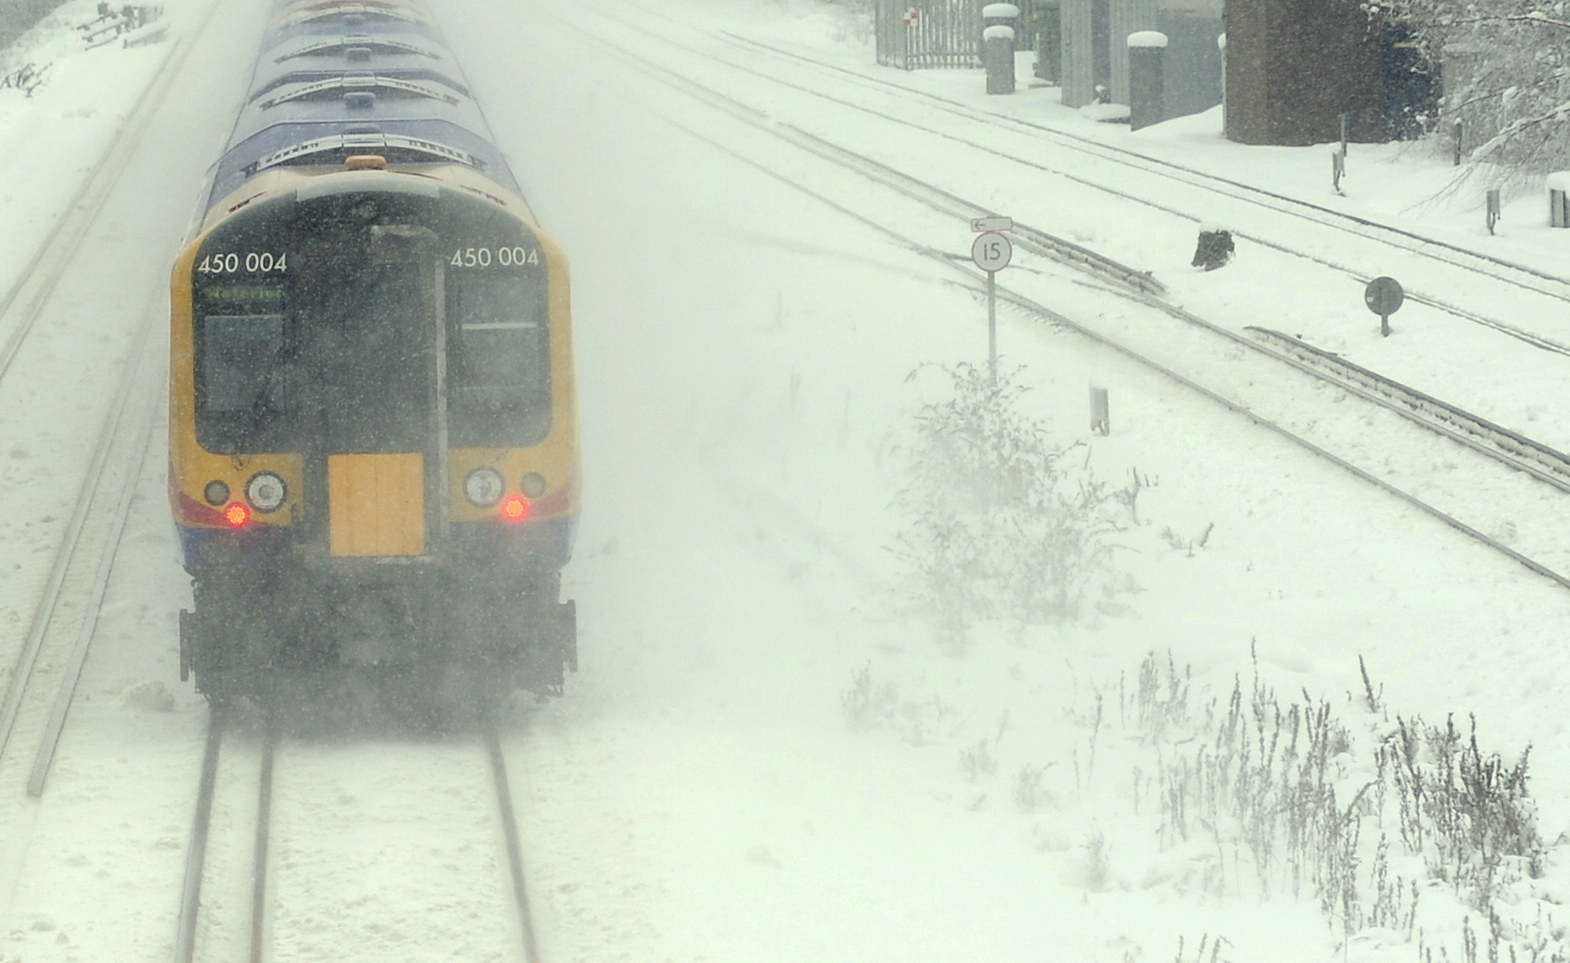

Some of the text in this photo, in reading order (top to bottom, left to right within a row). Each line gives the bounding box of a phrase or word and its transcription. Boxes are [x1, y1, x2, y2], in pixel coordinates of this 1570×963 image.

[450, 246, 539, 267] 450 004
[983, 242, 1001, 261] 15
[197, 252, 288, 274] 450 004
